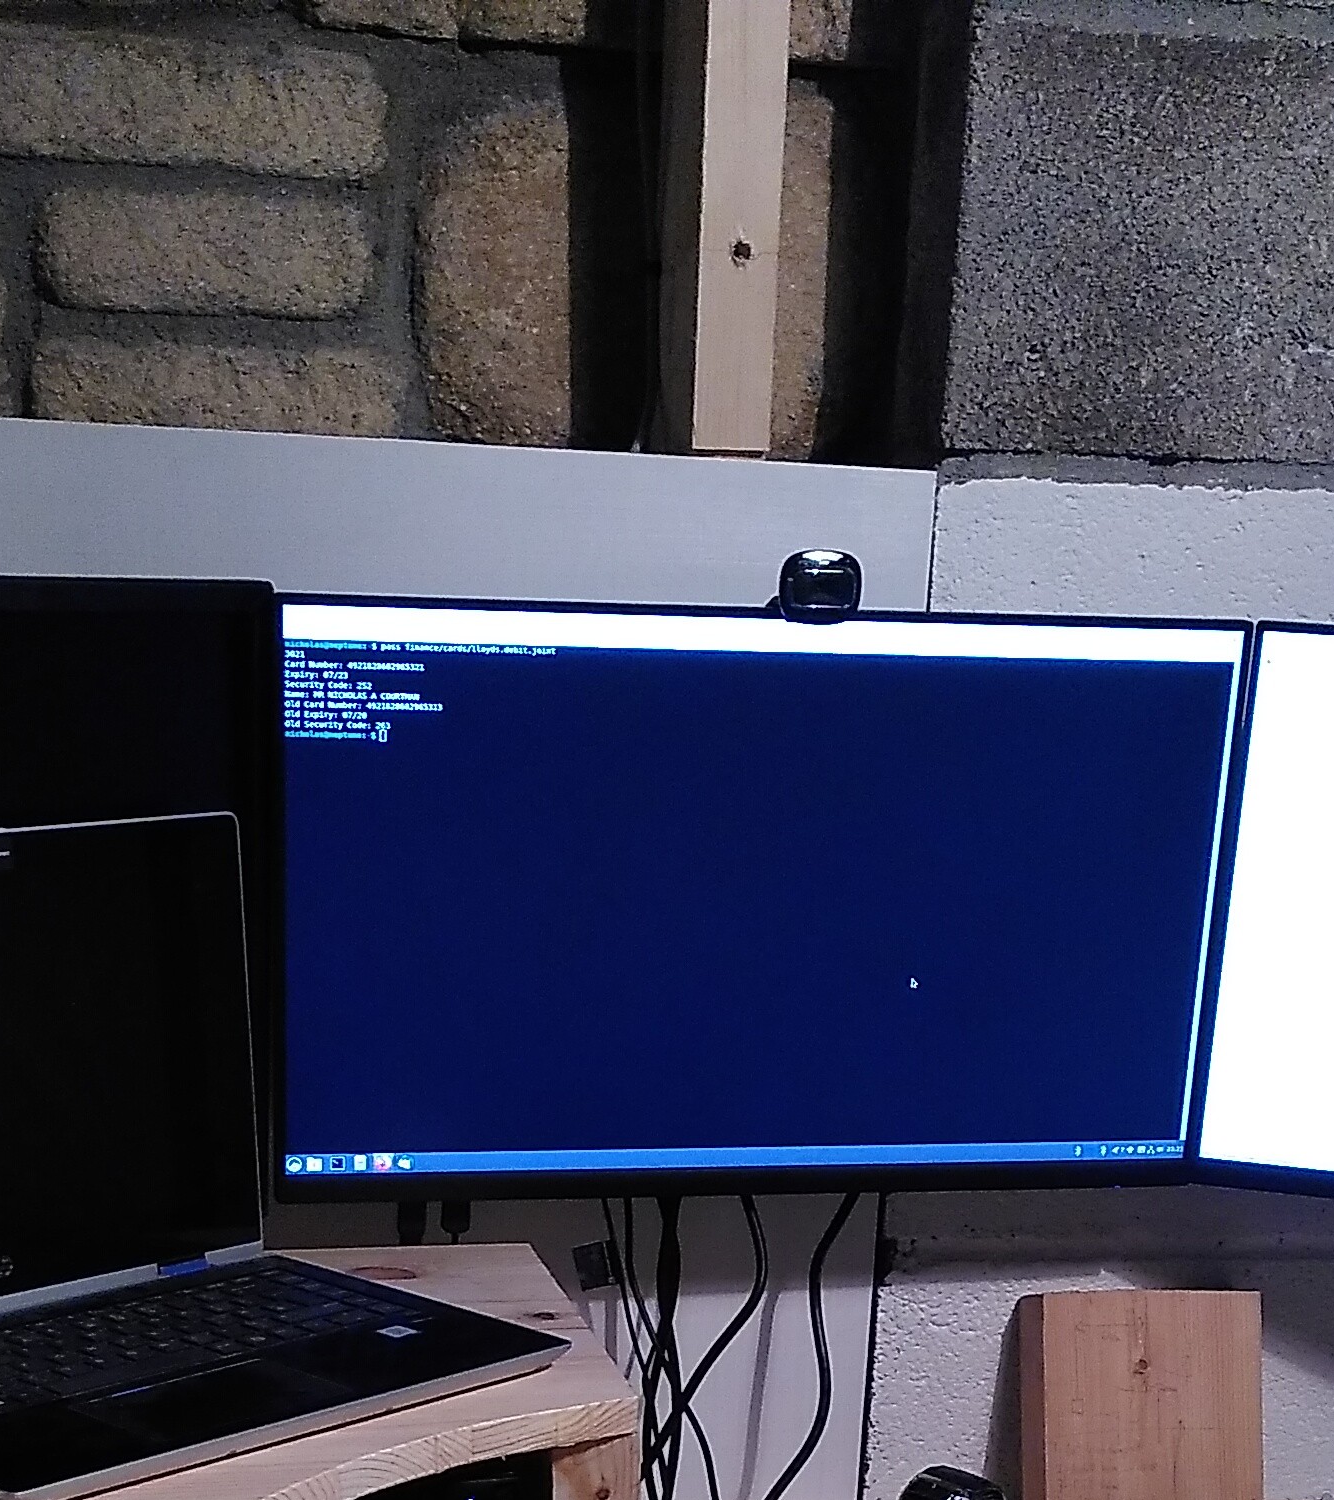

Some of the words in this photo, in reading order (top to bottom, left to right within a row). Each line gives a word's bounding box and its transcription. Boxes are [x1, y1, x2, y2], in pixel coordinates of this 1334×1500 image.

[284, 659, 306, 668] Card
[308, 660, 343, 669] Number:
[284, 670, 319, 680] Expiry:
[284, 680, 324, 690] Security
[328, 681, 352, 690] Code:
[284, 700, 301, 709] Old
[304, 701, 325, 709] Card
[284, 710, 301, 719] Old
[304, 711, 338, 720] Expiry:
[284, 720, 301, 729] Old
[304, 721, 344, 730] Security
[347, 721, 372, 730] Code:
